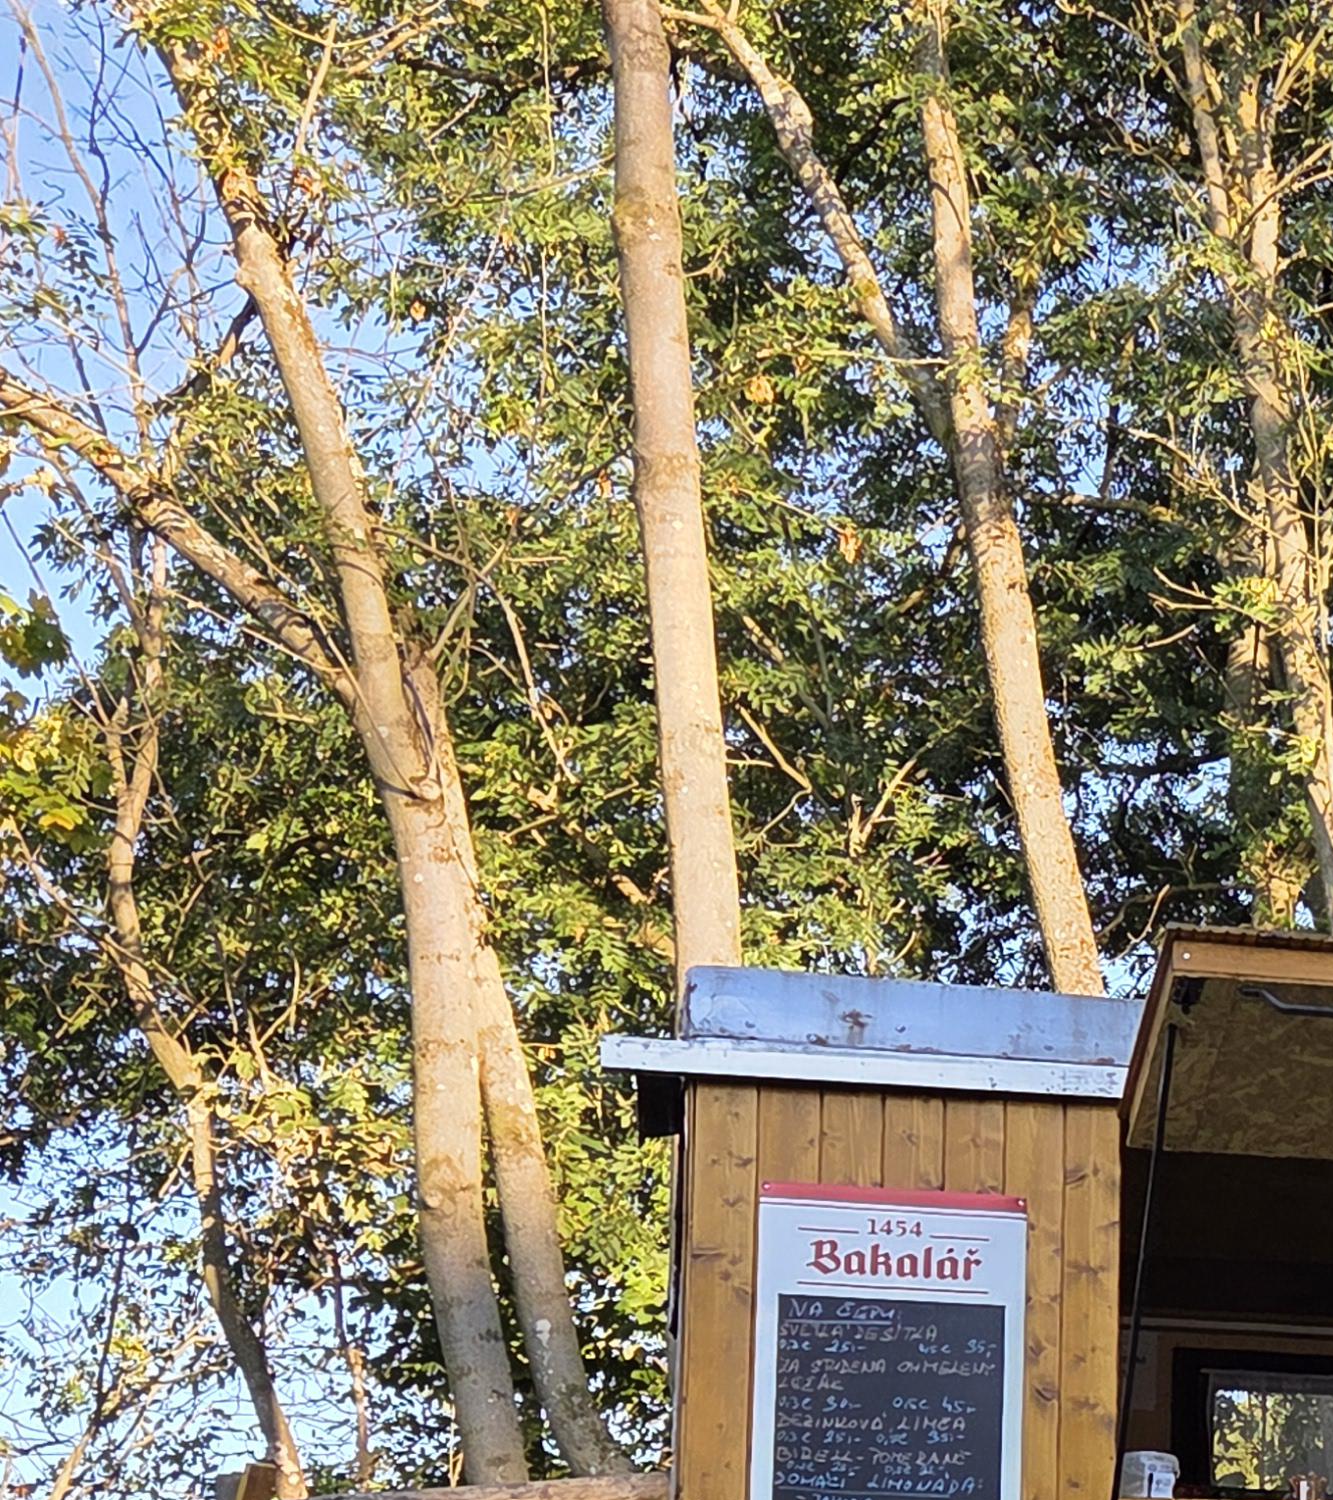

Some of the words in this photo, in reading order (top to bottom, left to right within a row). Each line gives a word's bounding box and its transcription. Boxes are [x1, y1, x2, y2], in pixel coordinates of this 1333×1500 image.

[866, 1218, 923, 1237] 1454
[806, 1239, 982, 1281] Bakalář
[788, 1299, 823, 1317] NA
